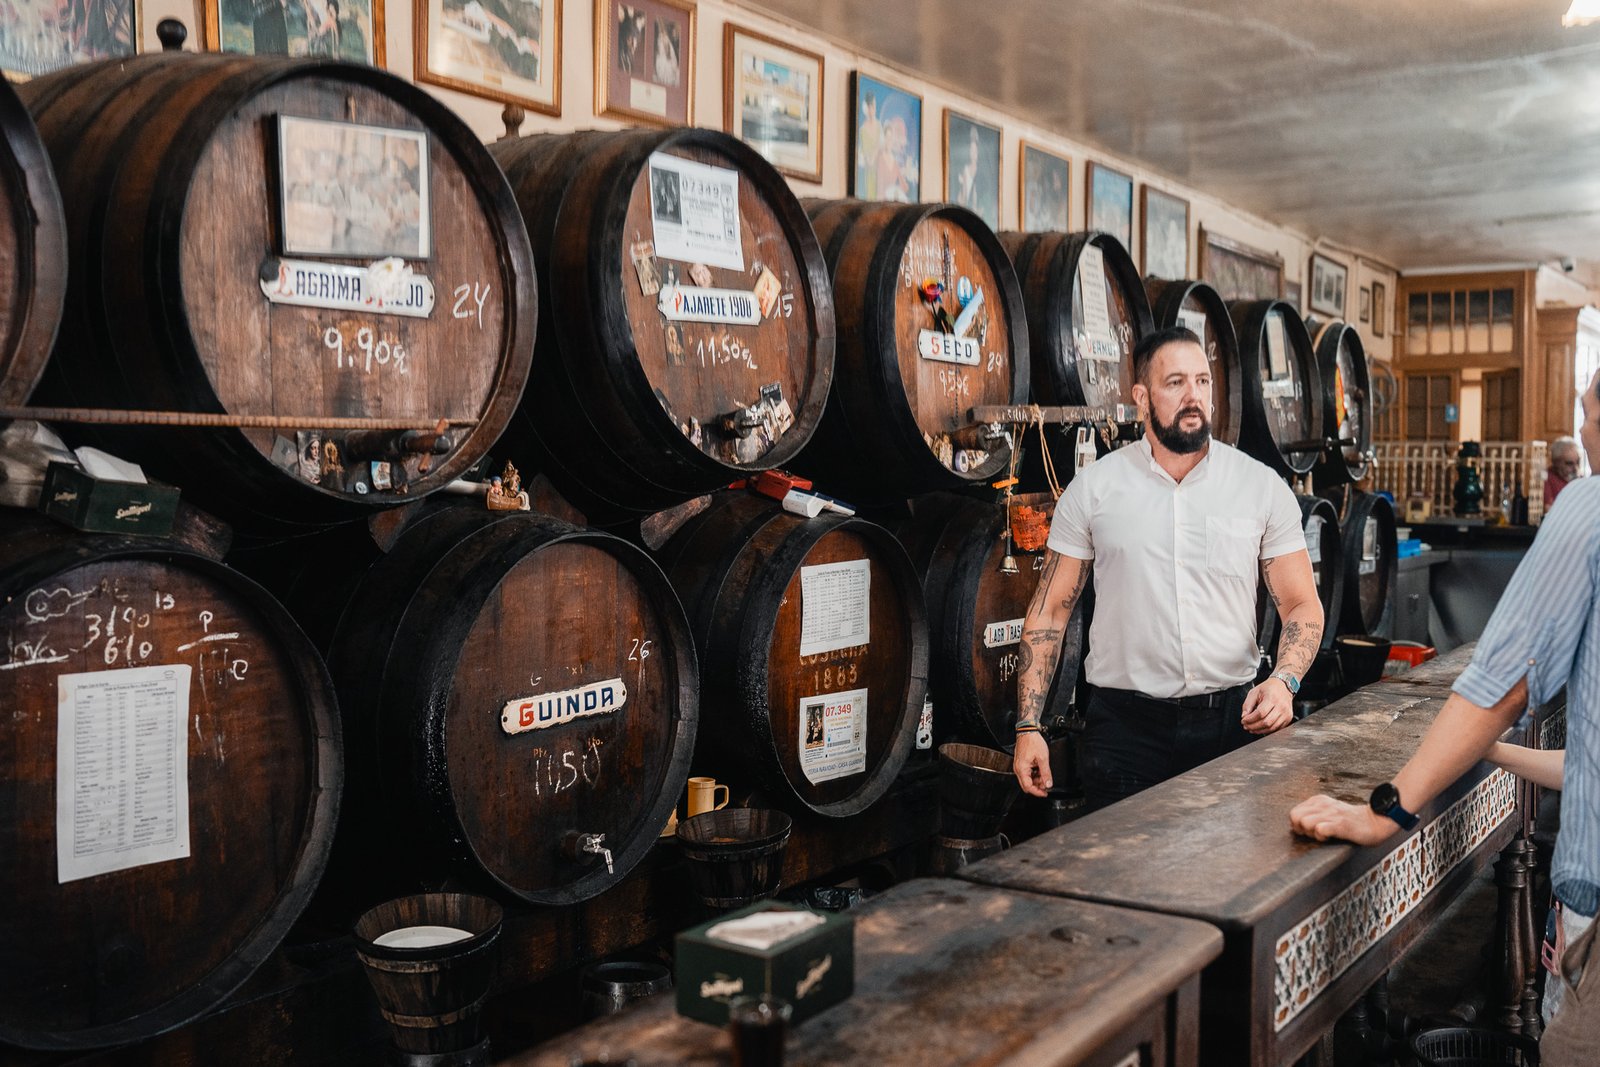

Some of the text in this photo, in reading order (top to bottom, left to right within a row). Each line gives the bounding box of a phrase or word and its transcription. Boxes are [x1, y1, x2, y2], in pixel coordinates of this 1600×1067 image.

[931, 336, 972, 358] SECO
[628, 638, 652, 661] 26
[518, 686, 614, 728] GUINDA
[825, 704, 852, 717] 07.349
